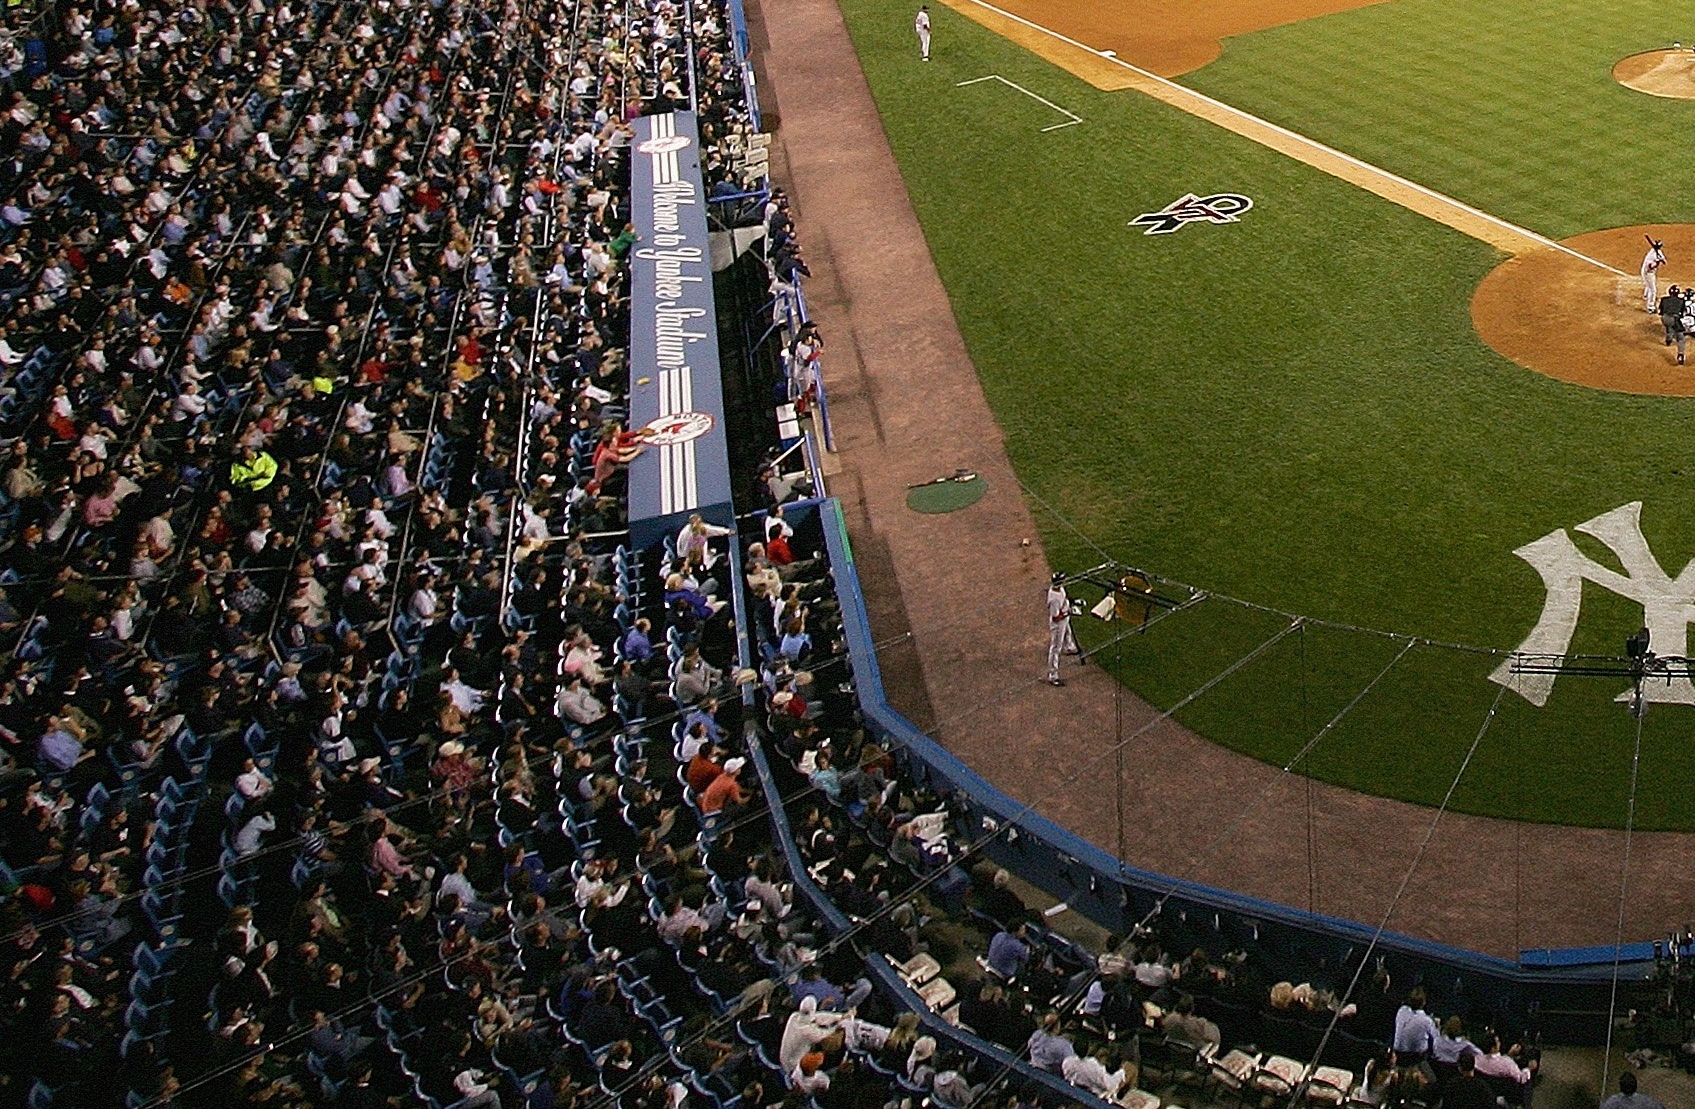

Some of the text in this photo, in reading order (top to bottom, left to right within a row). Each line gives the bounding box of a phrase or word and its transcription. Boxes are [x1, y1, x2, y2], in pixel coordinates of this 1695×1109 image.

[652, 180, 696, 232] Welcome
[654, 234, 687, 247] to
[636, 247, 704, 301] Yankee
[656, 301, 707, 368] Stadium
